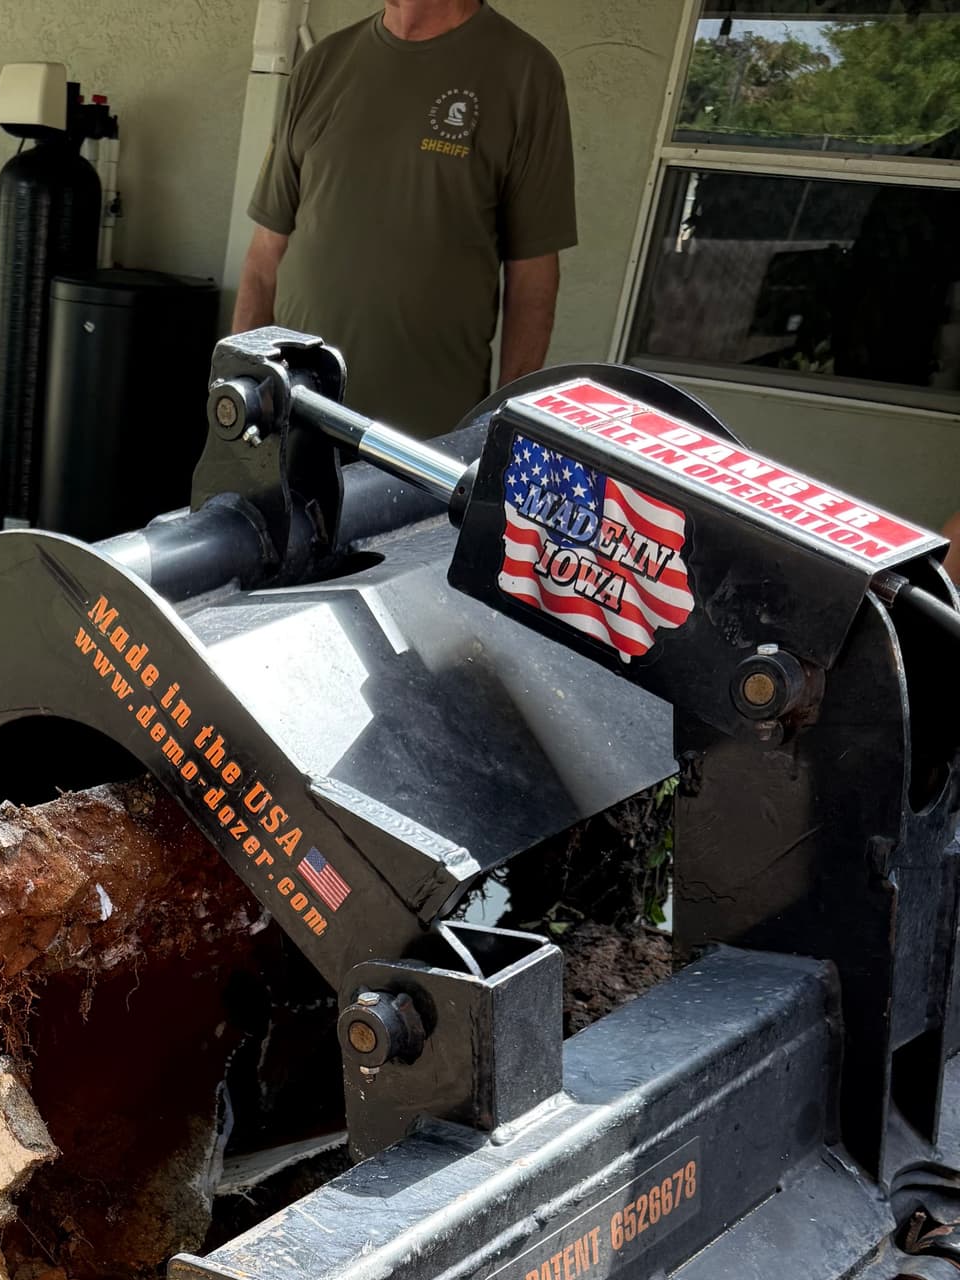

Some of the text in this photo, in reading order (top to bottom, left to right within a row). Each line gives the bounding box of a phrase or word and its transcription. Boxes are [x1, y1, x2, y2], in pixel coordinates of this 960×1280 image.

[421, 138, 470, 158] SHERIFF
[637, 443, 687, 465] IN
[682, 463, 891, 558] OPERATION
[657, 427, 881, 529] DANGER
[517, 483, 674, 583] MADE IN
[534, 539, 627, 614] IOWA
[87, 594, 304, 857] Made in the USA
[74, 626, 329, 937] www.demo-dozer.com
[610, 1160, 697, 1251] 6526678
